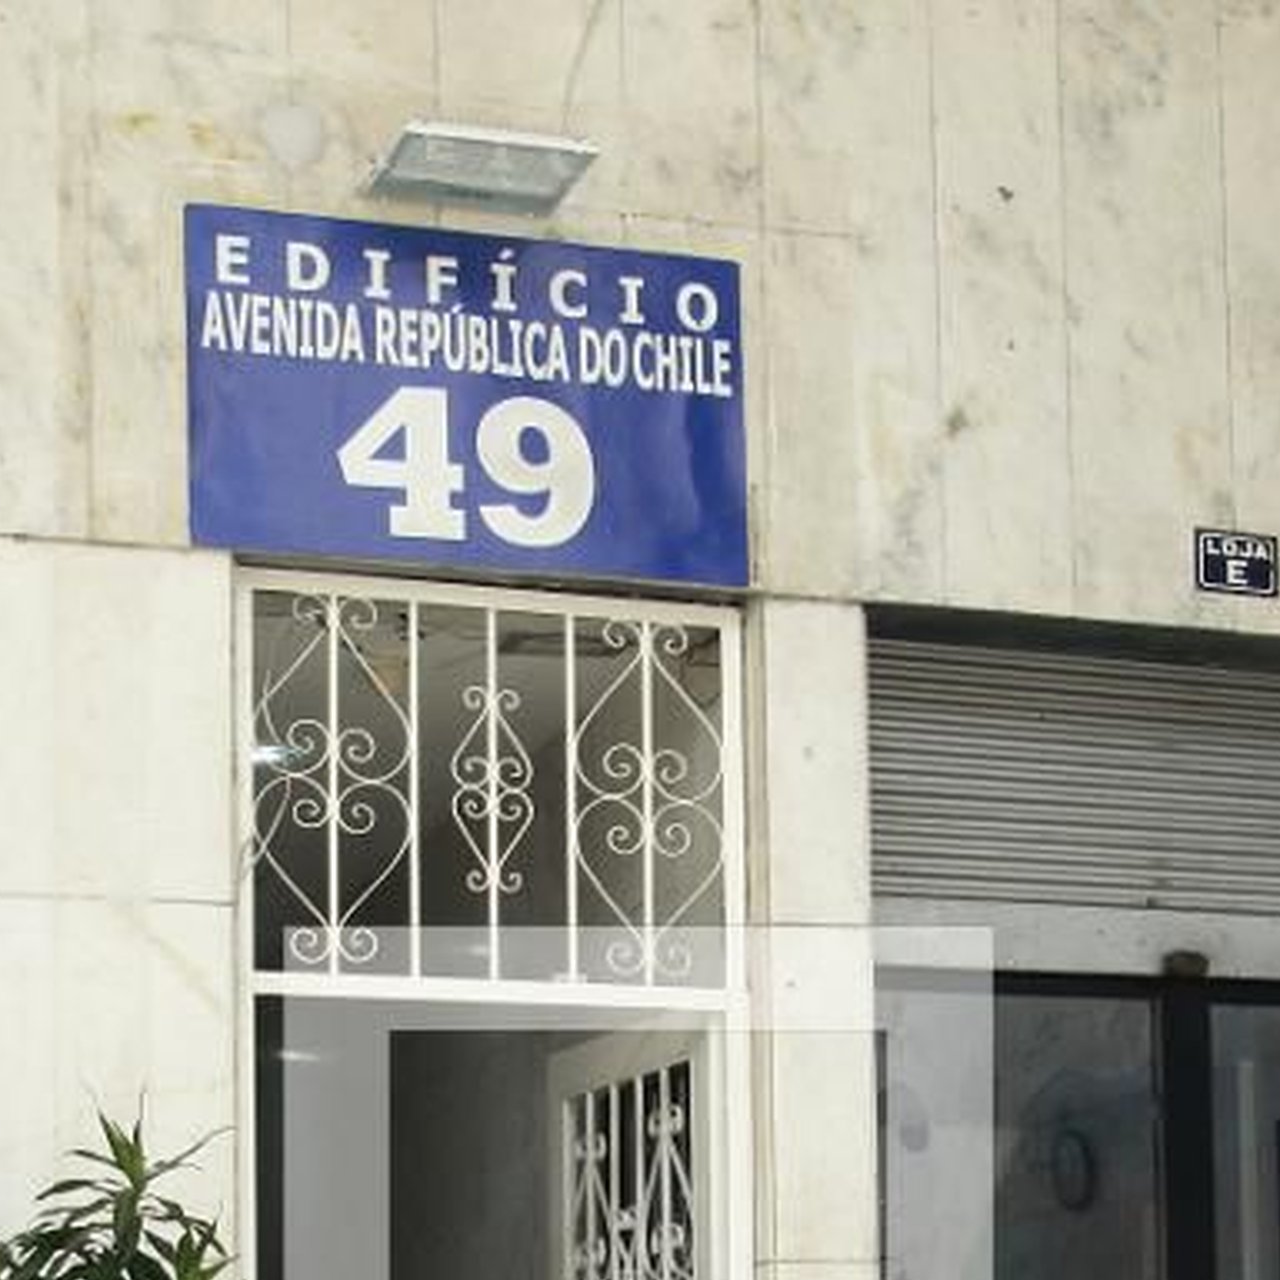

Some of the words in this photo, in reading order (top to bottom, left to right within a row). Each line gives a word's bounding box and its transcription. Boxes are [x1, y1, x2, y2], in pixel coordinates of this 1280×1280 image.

[215, 233, 719, 332] EDIFÍCIO
[201, 290, 364, 362] AVENIDA
[374, 304, 570, 382] REPÚBLICA
[578, 327, 628, 384] DO
[631, 336, 734, 396] CHILE
[336, 385, 596, 548] 49
[1206, 539, 1270, 560] LOJA
[1226, 560, 1248, 584] E
